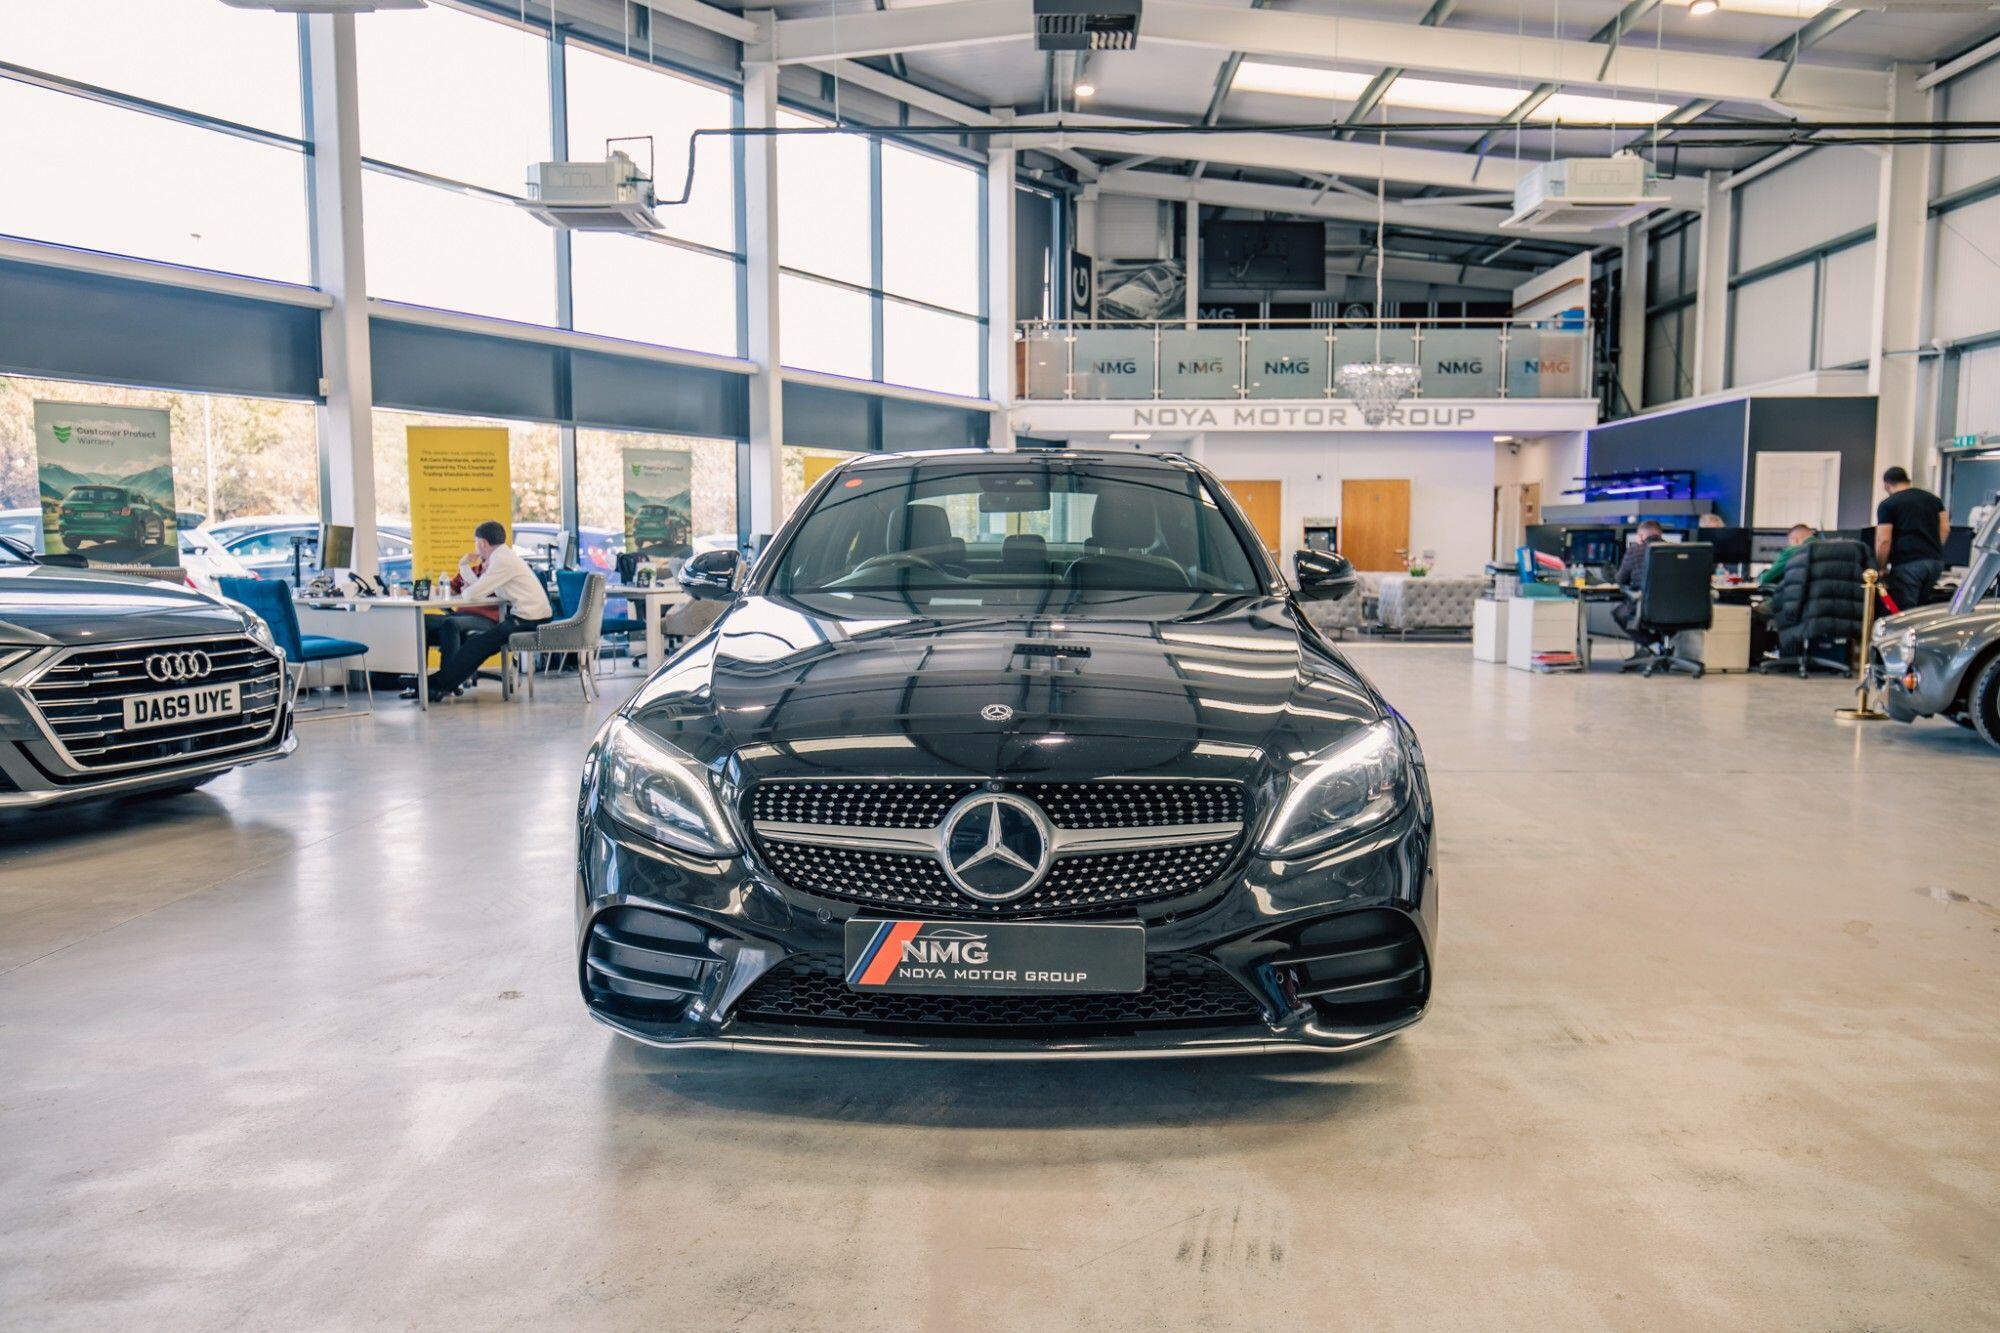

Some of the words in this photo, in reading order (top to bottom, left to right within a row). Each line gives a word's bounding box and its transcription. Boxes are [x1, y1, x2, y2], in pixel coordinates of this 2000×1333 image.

[1092, 361, 1136, 374] NMG
[1178, 361, 1223, 374] NMG
[1264, 361, 1310, 374] NMG
[1437, 361, 1483, 374] NMG
[1524, 361, 1570, 374] NMG
[1133, 408, 1218, 426] NOYA
[1234, 408, 1348, 426] MOTOR
[76, 426, 121, 437] Customer
[124, 430, 156, 439] Protect
[77, 437, 115, 448] Warranty
[134, 695, 190, 724] DA69
[195, 689, 233, 714] UYE
[900, 940, 989, 964] NMG
[900, 968, 947, 979] NOYA
[954, 969, 1017, 981] MOTOR
[1025, 971, 1087, 983] GROUP
